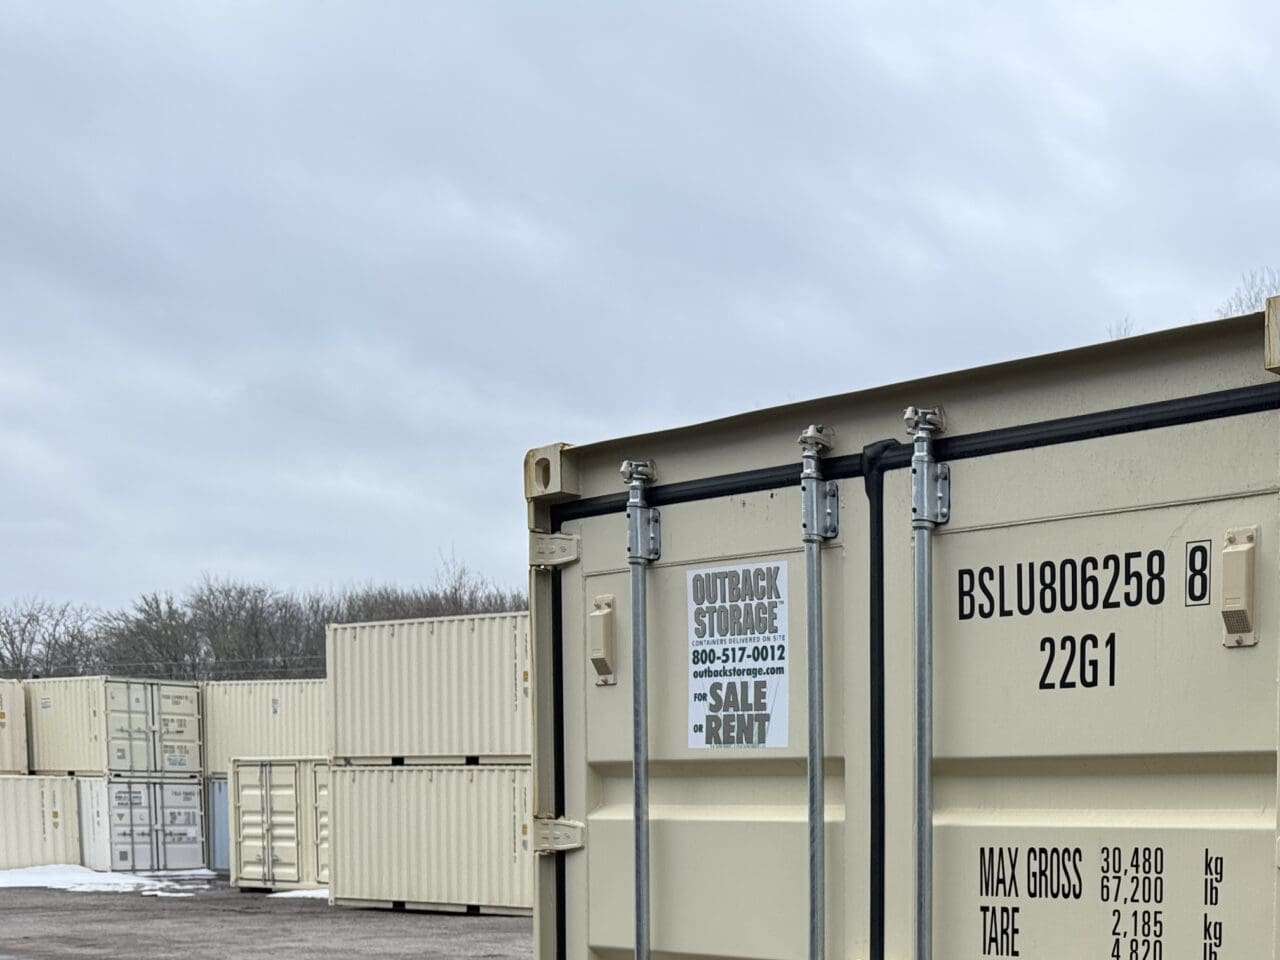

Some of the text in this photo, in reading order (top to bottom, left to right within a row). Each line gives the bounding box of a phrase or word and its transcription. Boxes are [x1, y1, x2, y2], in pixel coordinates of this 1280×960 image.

[692, 566, 781, 605] OUTBACK
[958, 545, 1207, 620] BSLU806258 8
[694, 601, 779, 638] STORAGE
[691, 638, 727, 647] CONTAINERS
[728, 636, 761, 645] DELIVERED
[773, 634, 785, 642] SITE
[692, 644, 785, 665] 800-517-0012
[693, 665, 785, 679] outbackstorage.com
[1039, 632, 1116, 690] 22G1
[694, 680, 767, 713] FOR SALE
[693, 713, 770, 745] OR RENT
[979, 847, 1223, 899] MAX GROSS 30,480 kg
[1100, 876, 1218, 906] 67,200 lb
[980, 906, 1223, 957] TARE 2,185 kg
